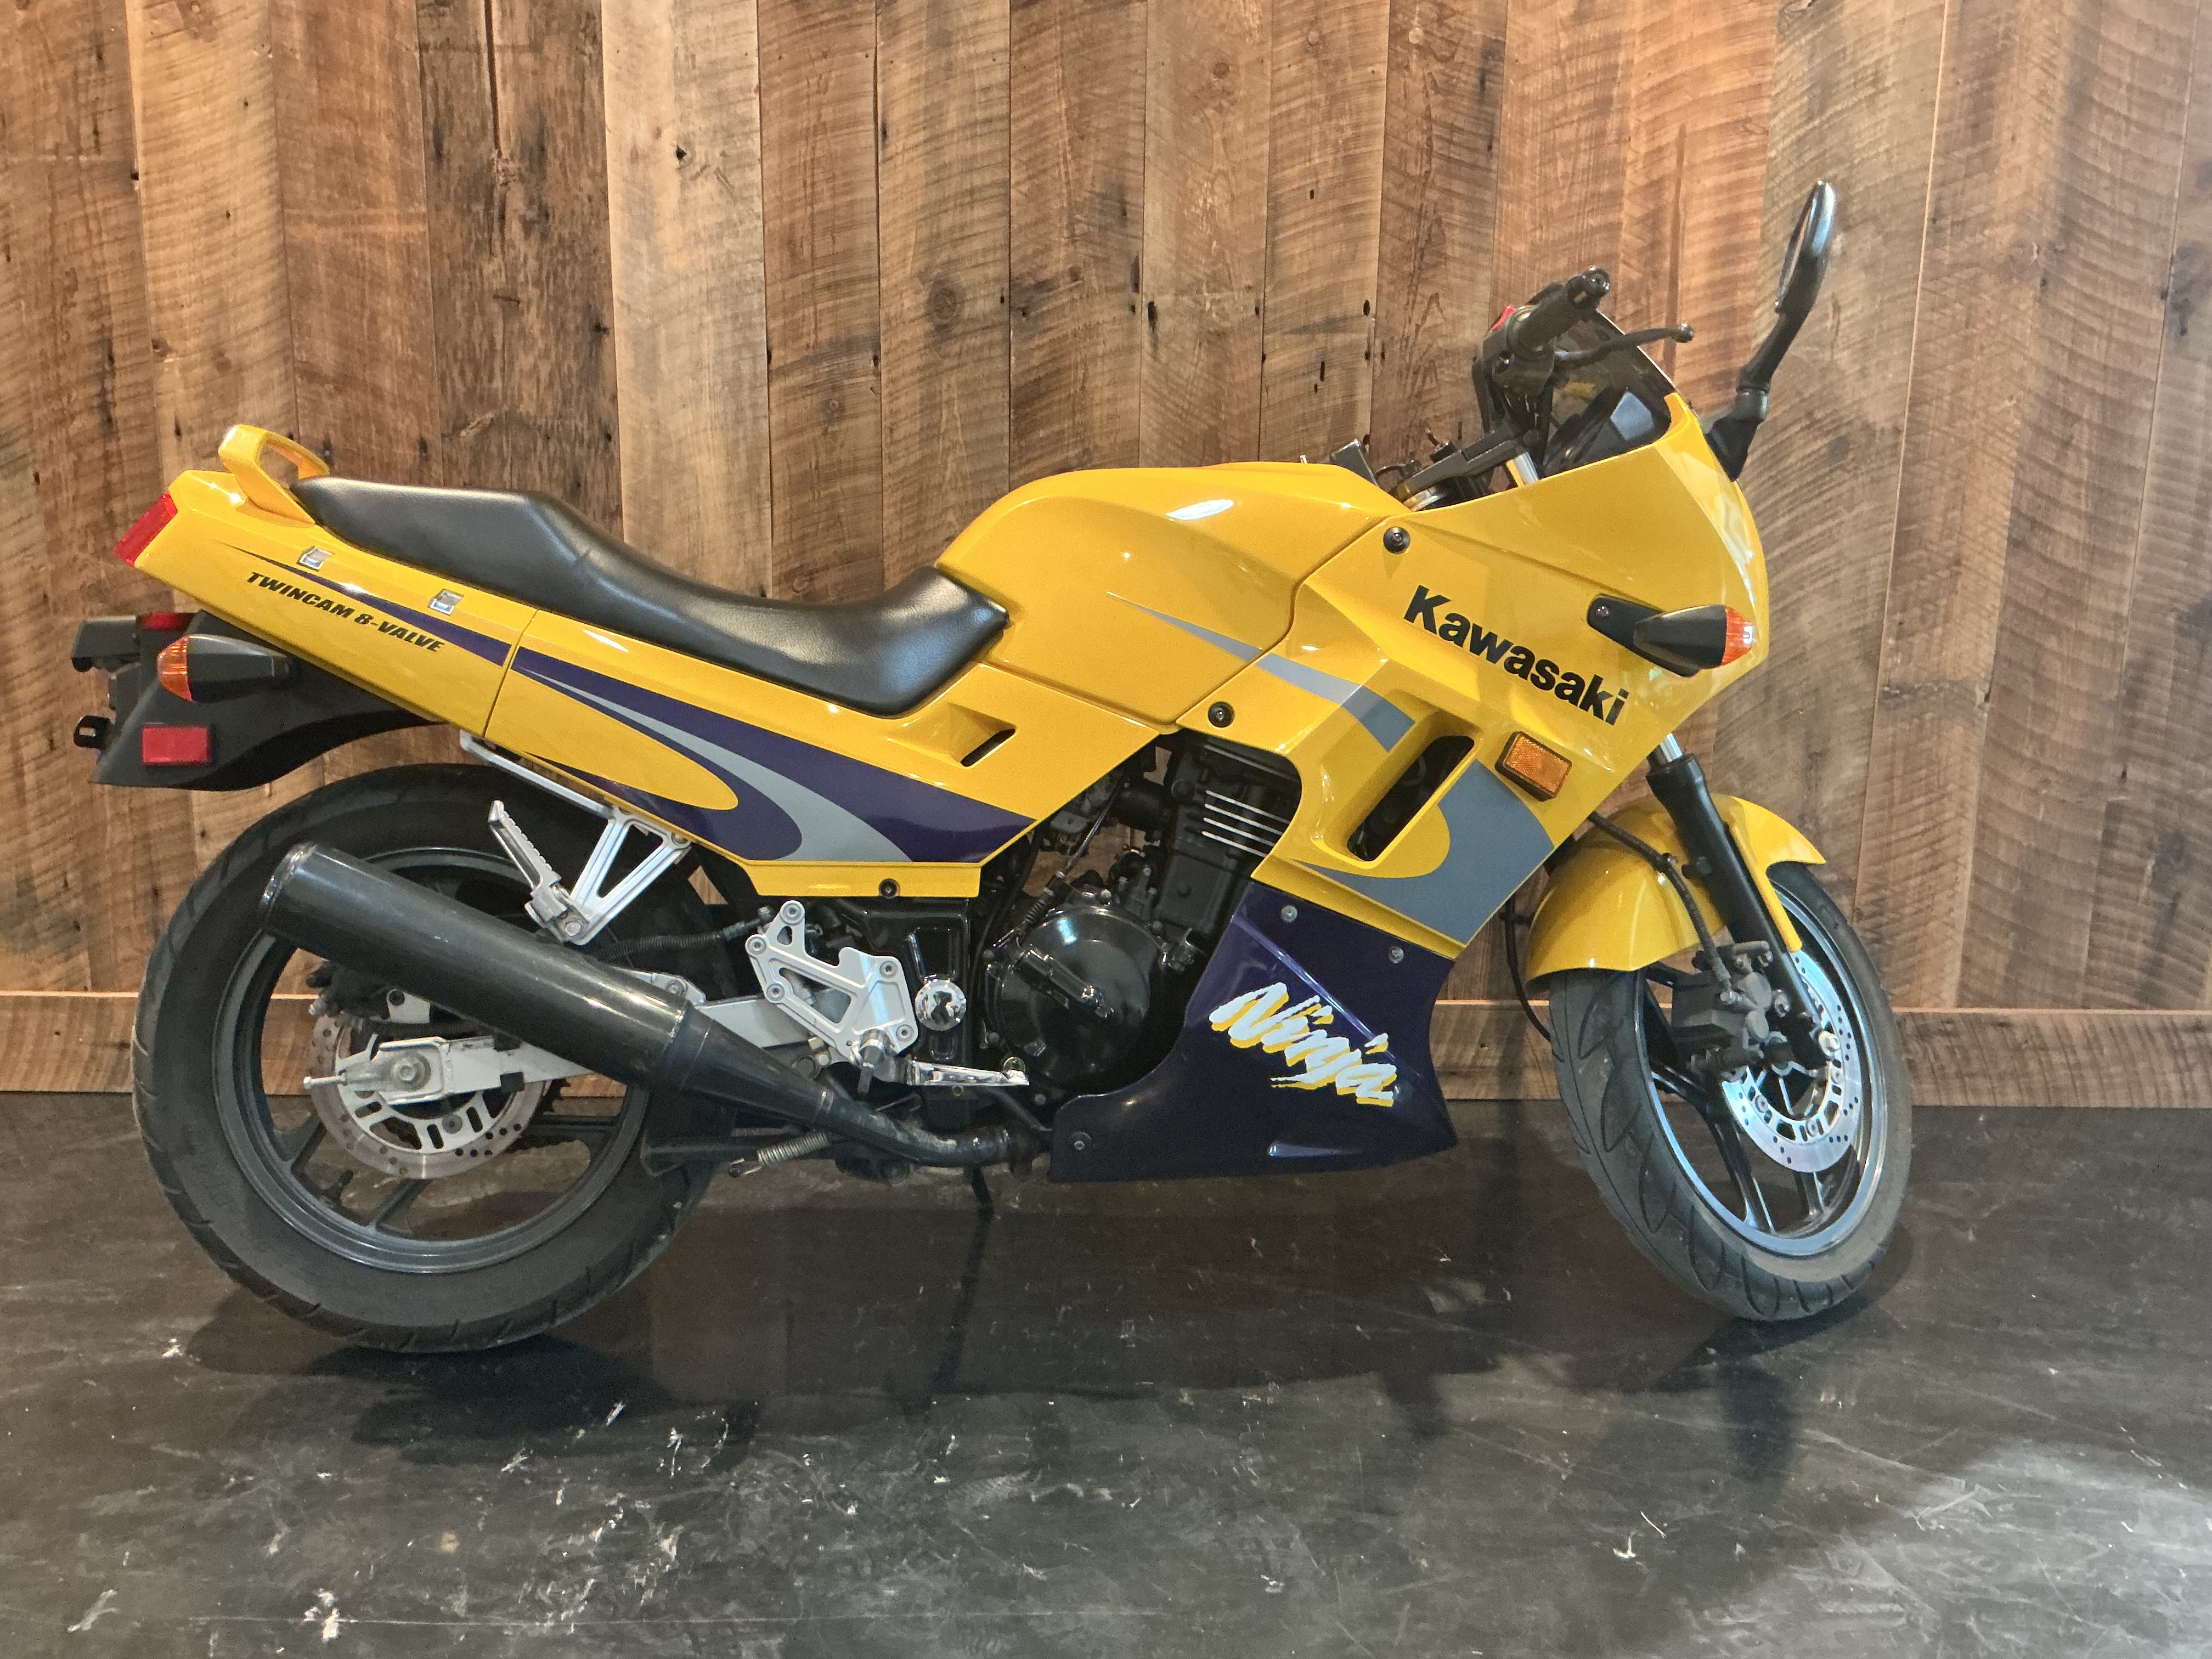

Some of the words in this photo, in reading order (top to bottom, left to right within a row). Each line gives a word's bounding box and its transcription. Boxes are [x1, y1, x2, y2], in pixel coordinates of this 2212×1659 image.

[247, 572, 356, 618] TWINCAM
[354, 613, 445, 652] 8-VALVE
[1404, 585, 1629, 726] Kawasaki
[1209, 981, 1397, 1107] Ninja
